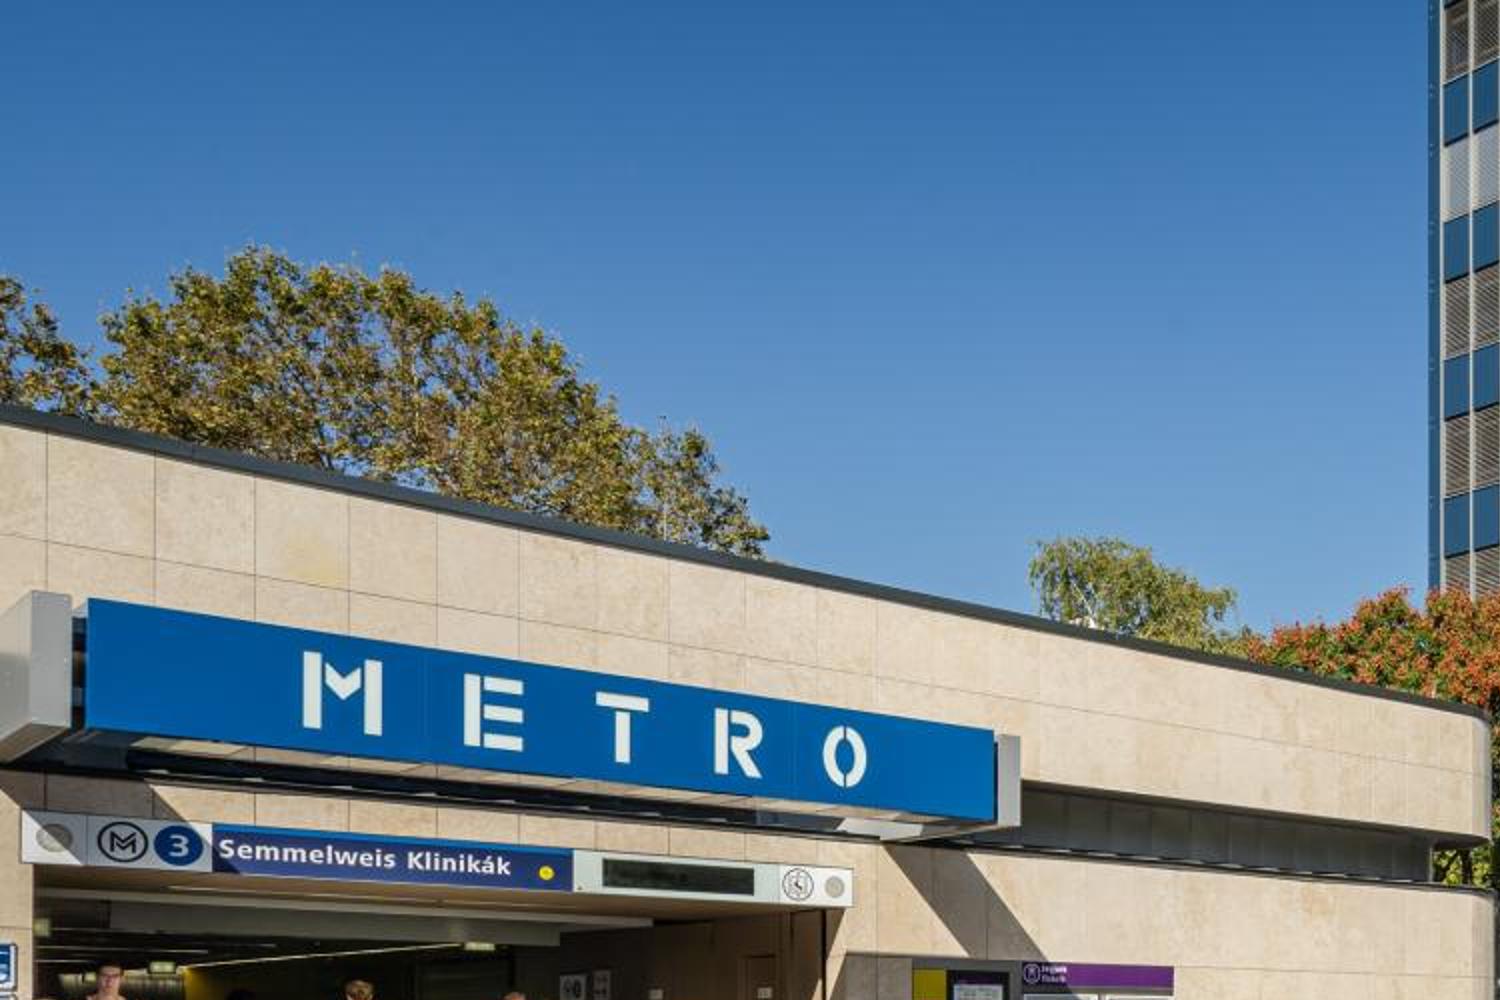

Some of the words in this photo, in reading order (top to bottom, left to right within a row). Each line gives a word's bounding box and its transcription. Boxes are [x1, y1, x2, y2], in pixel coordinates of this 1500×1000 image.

[302, 650, 868, 789] METRO
[168, 834, 191, 858] 3
[219, 838, 397, 869] Semmelweis
[407, 849, 512, 876] Klinikák
